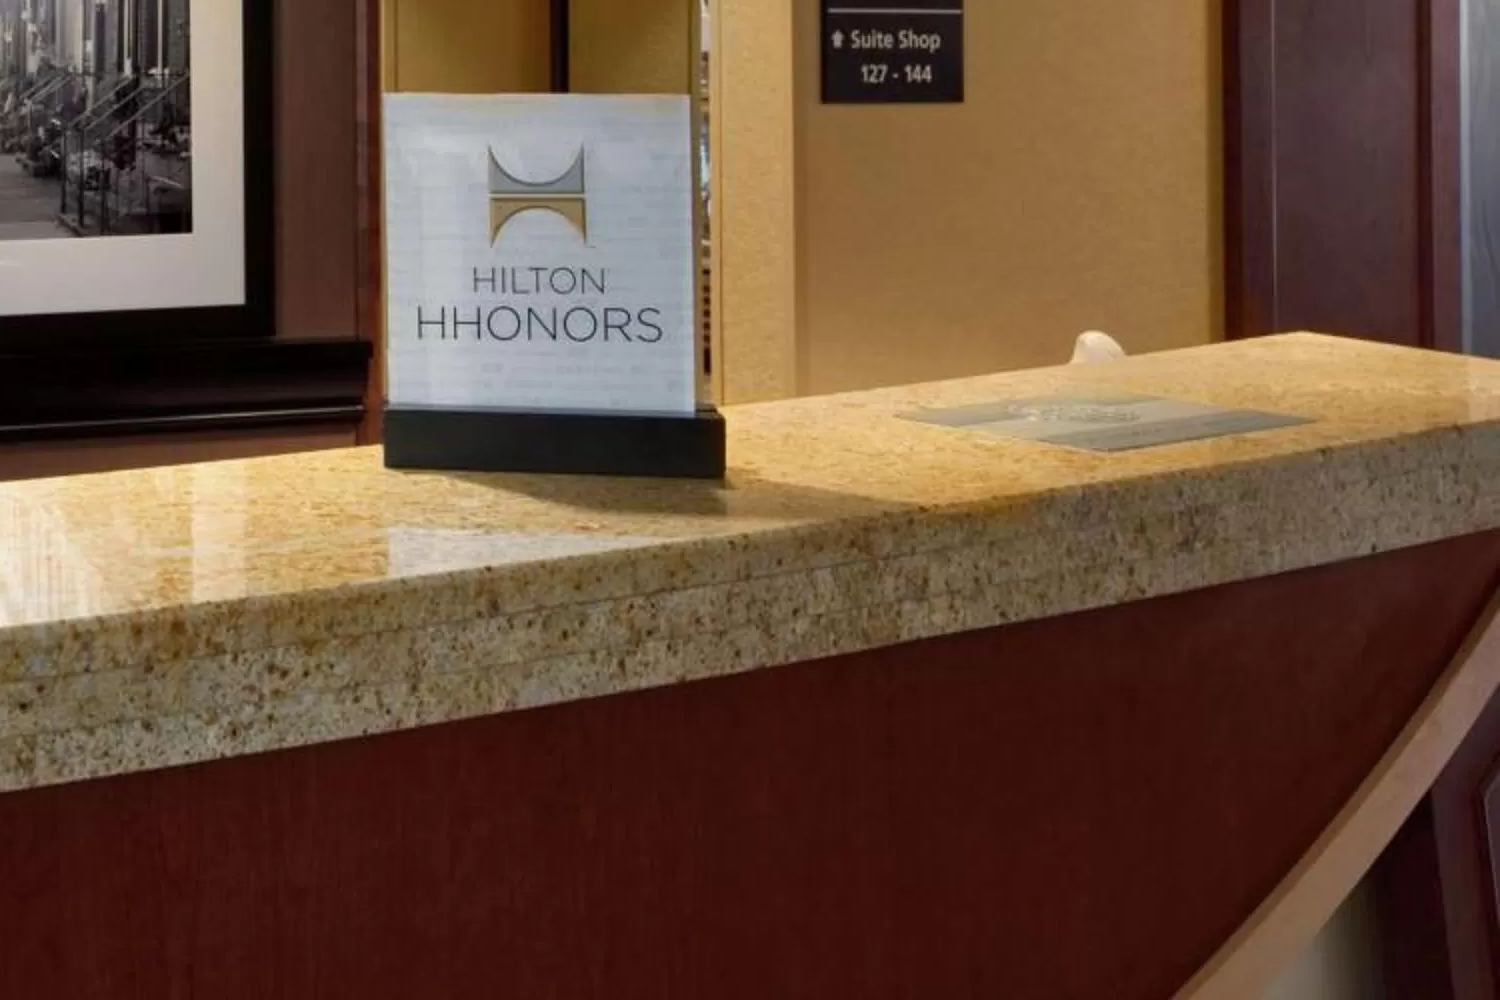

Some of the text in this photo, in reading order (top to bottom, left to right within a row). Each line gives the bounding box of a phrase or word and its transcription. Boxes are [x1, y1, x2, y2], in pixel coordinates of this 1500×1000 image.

[851, 29, 941, 53] Suite Shop
[861, 64, 889, 83] 127
[904, 64, 933, 83] 144
[472, 266, 606, 295] HILTON
[416, 304, 664, 343] HHONORS
